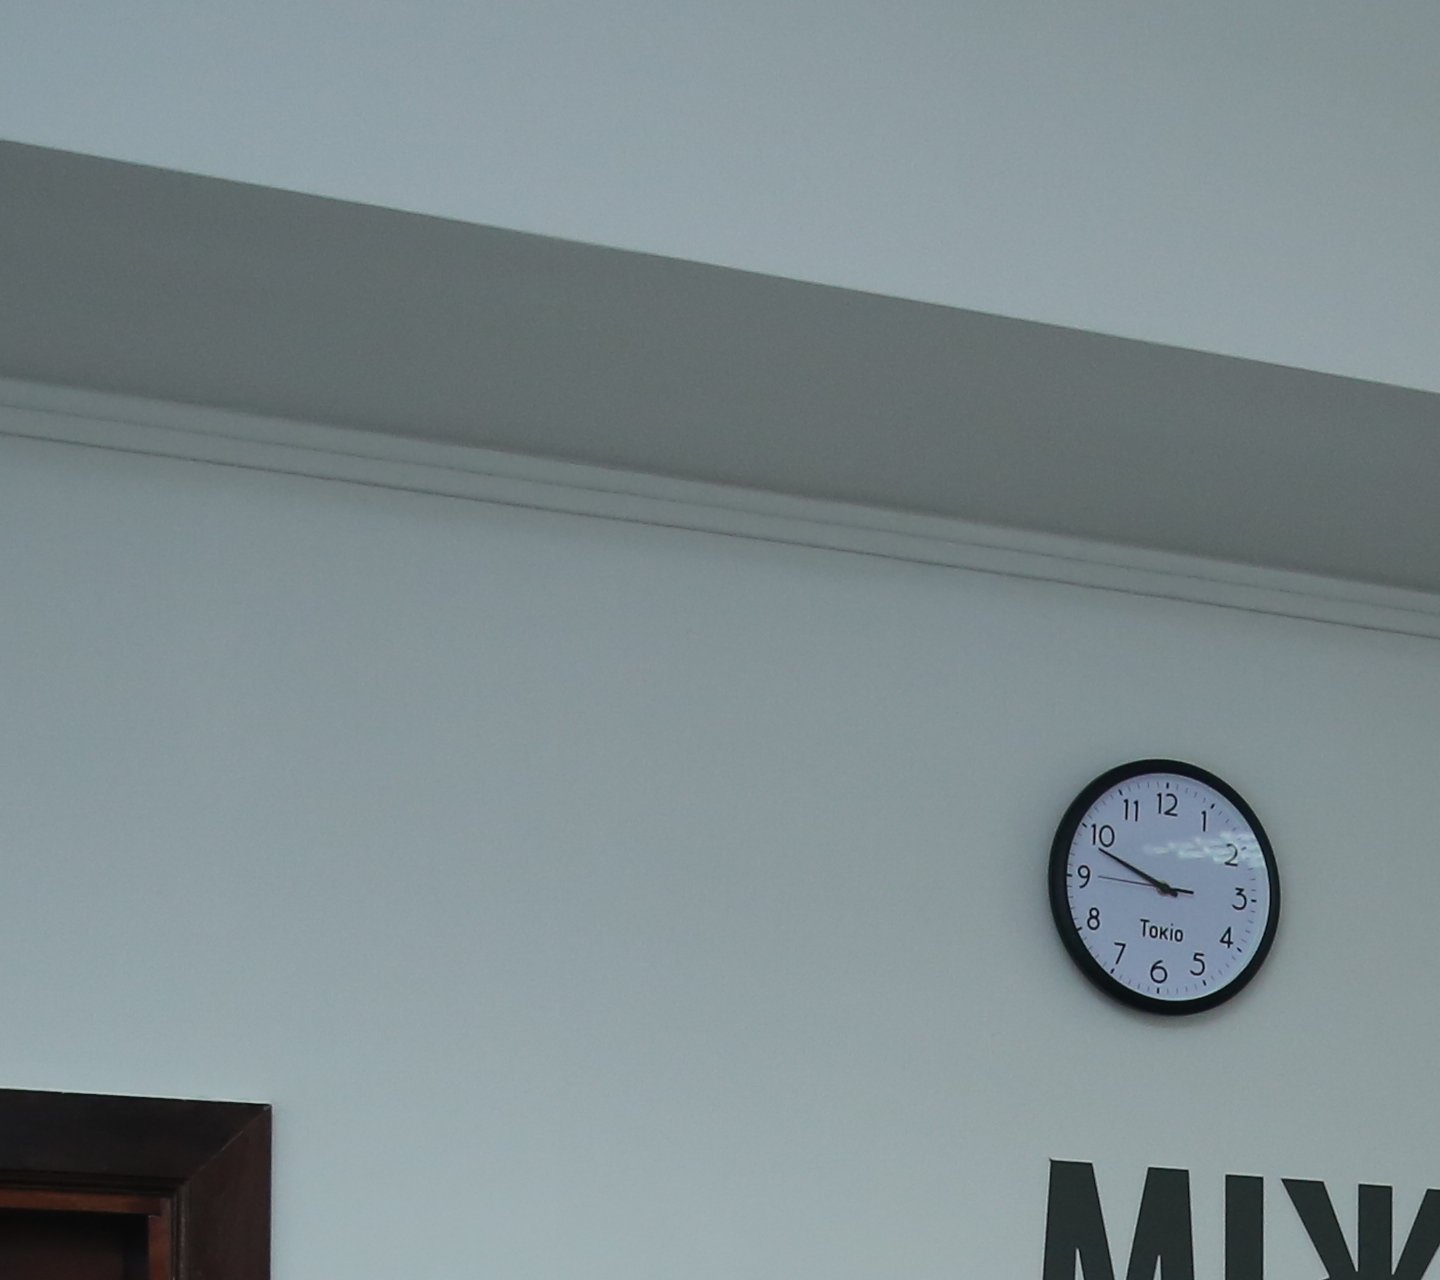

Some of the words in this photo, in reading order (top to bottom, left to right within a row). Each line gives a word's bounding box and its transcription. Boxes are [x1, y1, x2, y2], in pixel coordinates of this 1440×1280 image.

[1124, 799, 1138, 821] 11
[1157, 793, 1178, 816] 12
[1201, 811, 1206, 832] 1
[1091, 824, 1115, 847] 10
[1225, 843, 1238, 866] 2
[1078, 865, 1090, 888] 9
[1232, 888, 1247, 910] 3
[1087, 907, 1100, 930] 8
[1220, 927, 1233, 948] 4
[1114, 942, 1126, 965] 7
[1190, 953, 1205, 976] 5
[1150, 960, 1167, 983] 6
